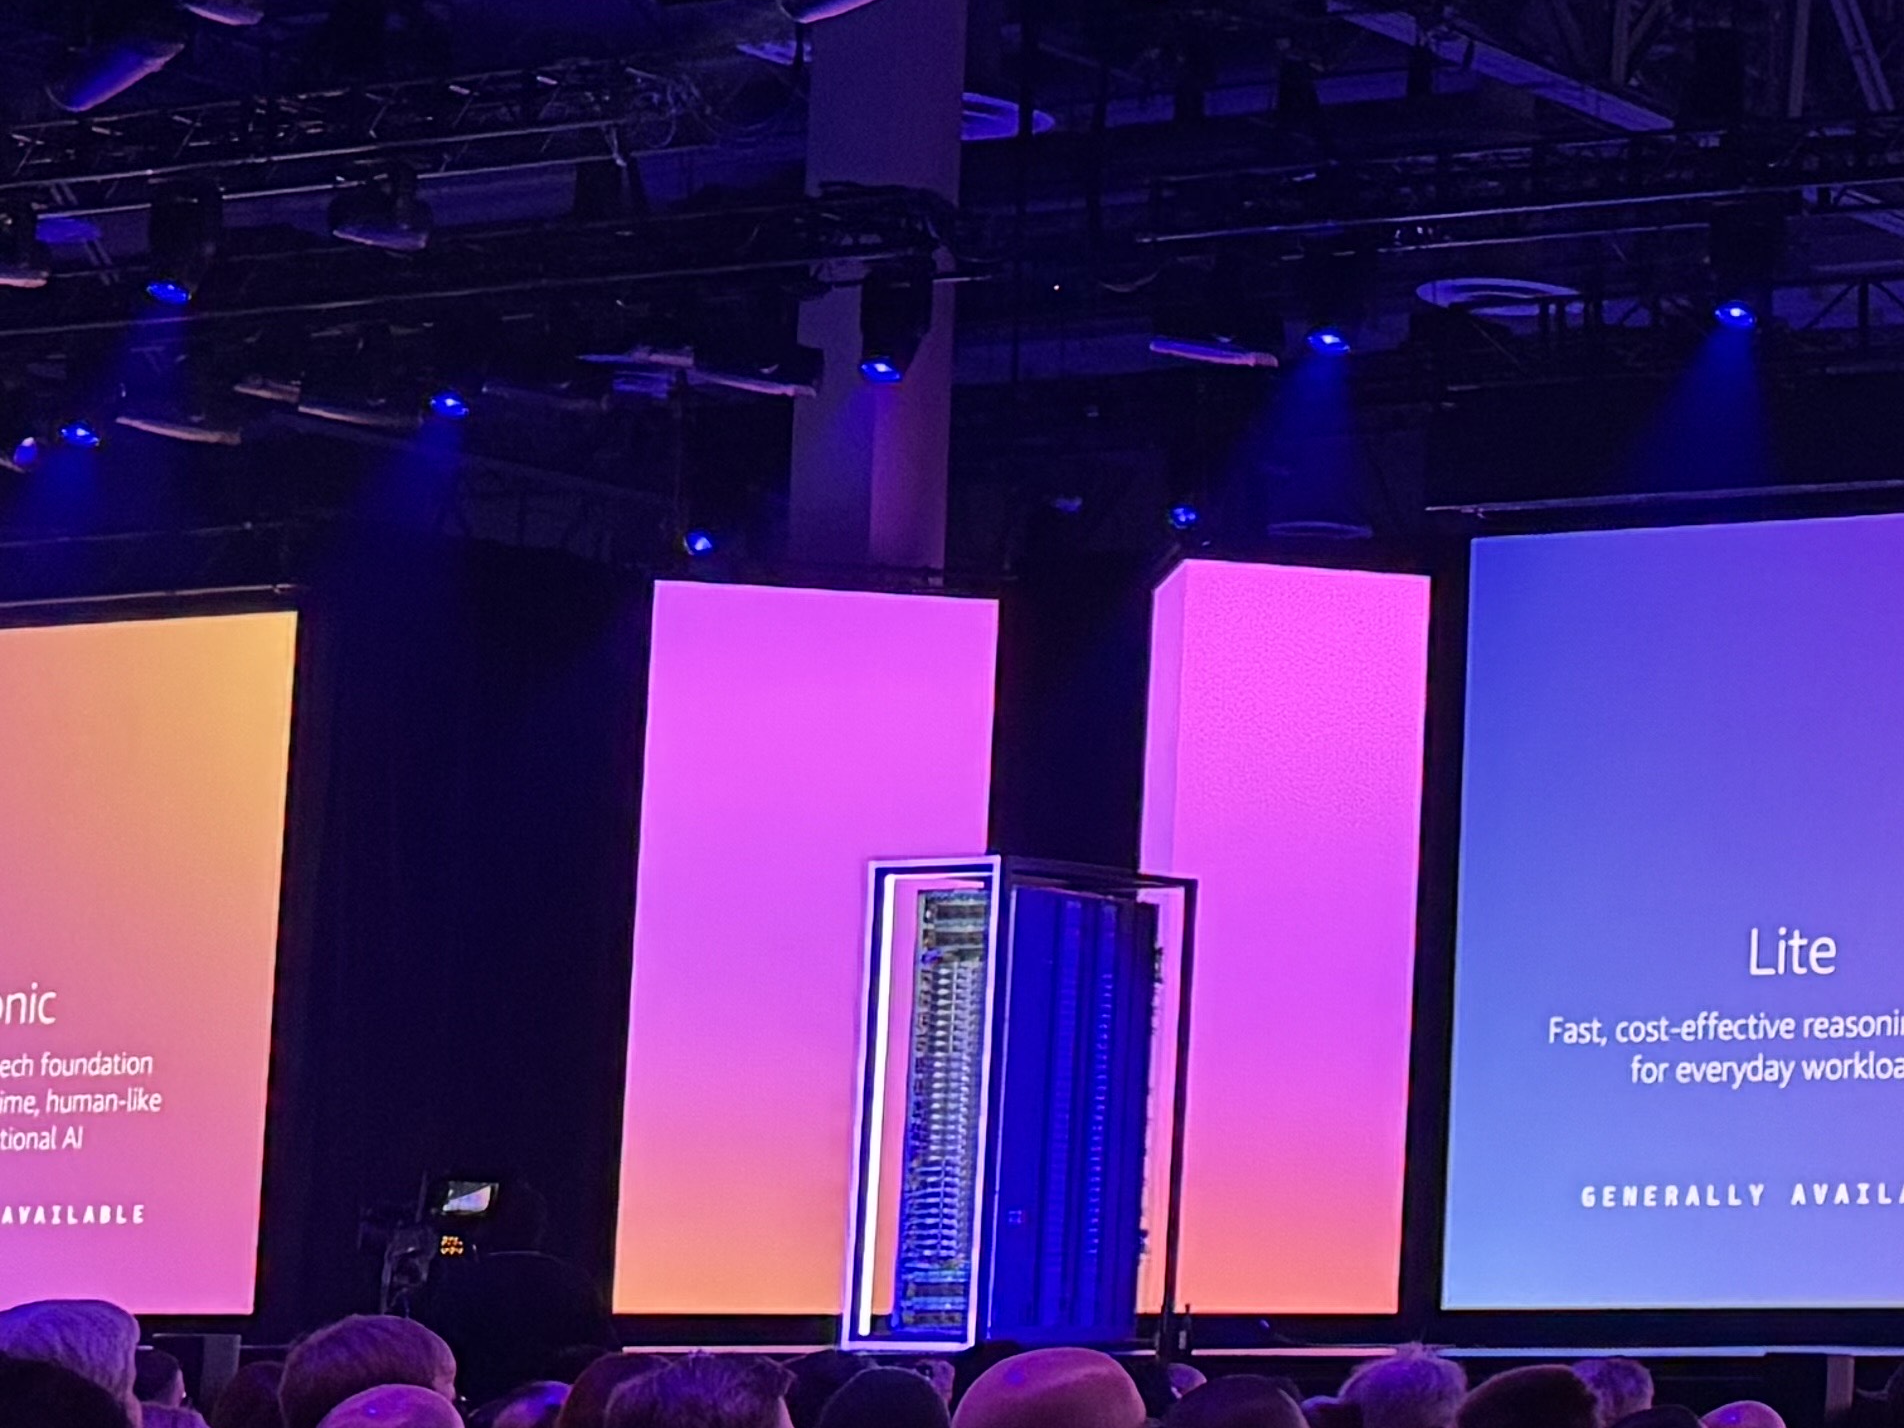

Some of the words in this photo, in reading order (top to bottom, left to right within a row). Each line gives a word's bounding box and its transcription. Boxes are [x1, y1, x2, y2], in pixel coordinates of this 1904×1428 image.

[1749, 926, 1837, 976] Lite
[1548, 1016, 1608, 1047] Fast,
[1615, 1010, 1796, 1043] cost-effective
[40, 1051, 153, 1077] foundation
[1630, 1054, 1670, 1084] for
[1675, 1052, 1796, 1090] everyday
[45, 1087, 163, 1114] human-like
[61, 1125, 84, 1149] AI
[1581, 1183, 1764, 1208] GENERALLY
[1, 1204, 144, 1225] AVAILABLE
